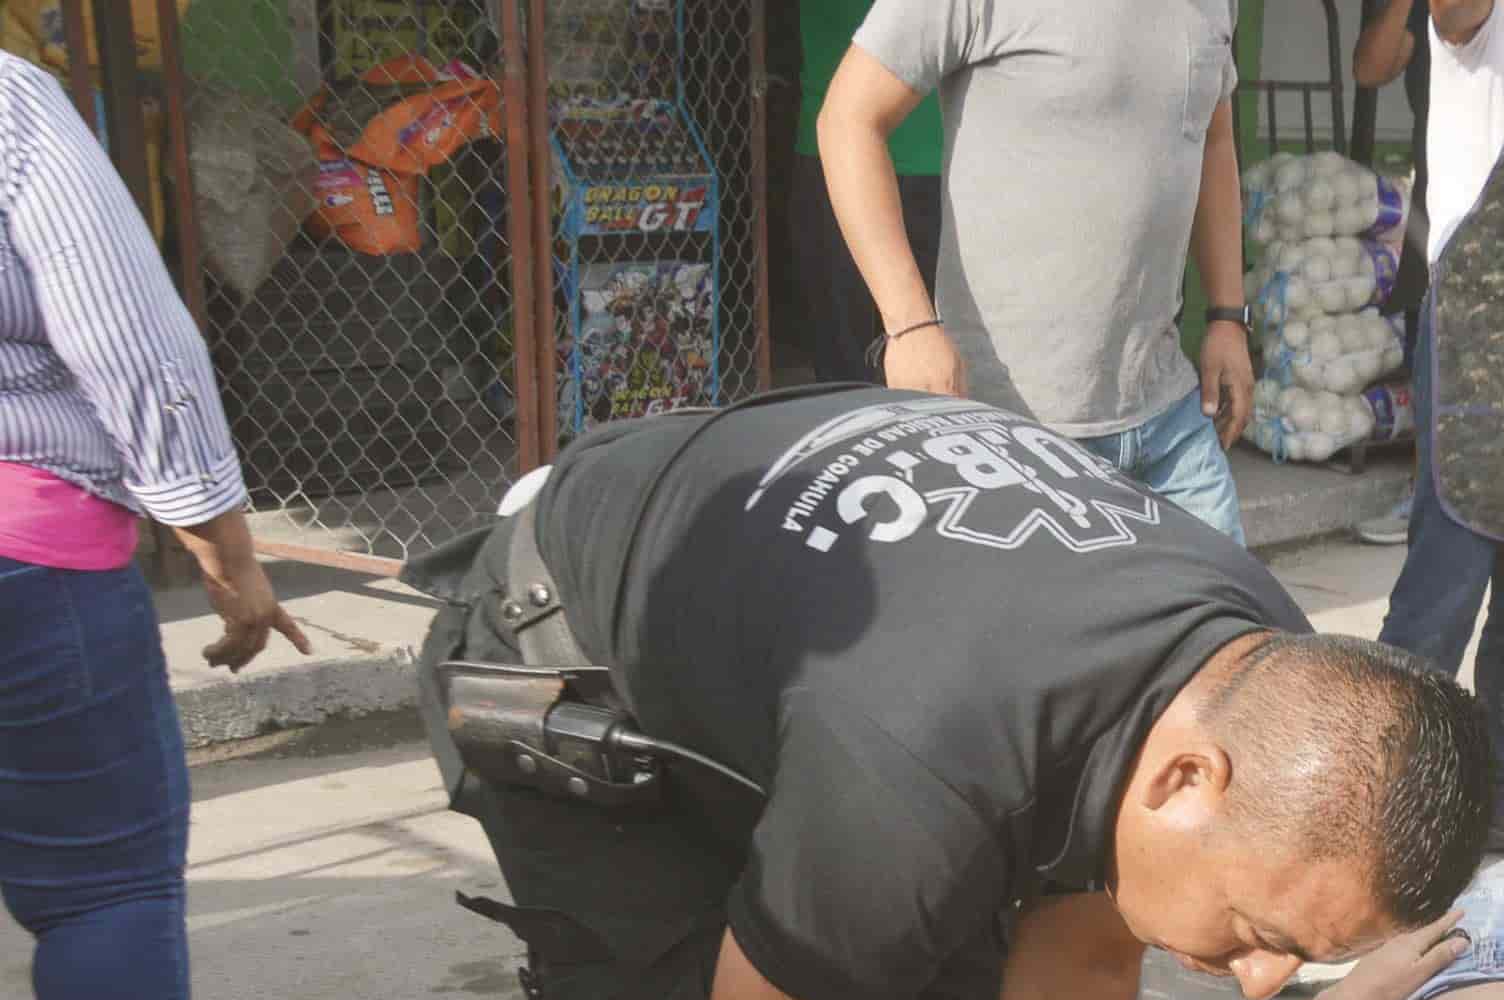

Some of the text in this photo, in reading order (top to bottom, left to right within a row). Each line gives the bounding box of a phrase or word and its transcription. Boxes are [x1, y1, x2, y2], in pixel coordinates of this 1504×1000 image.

[638, 201, 705, 232] GT
[851, 437, 886, 457] DE
[781, 453, 860, 533] COAHUILA
